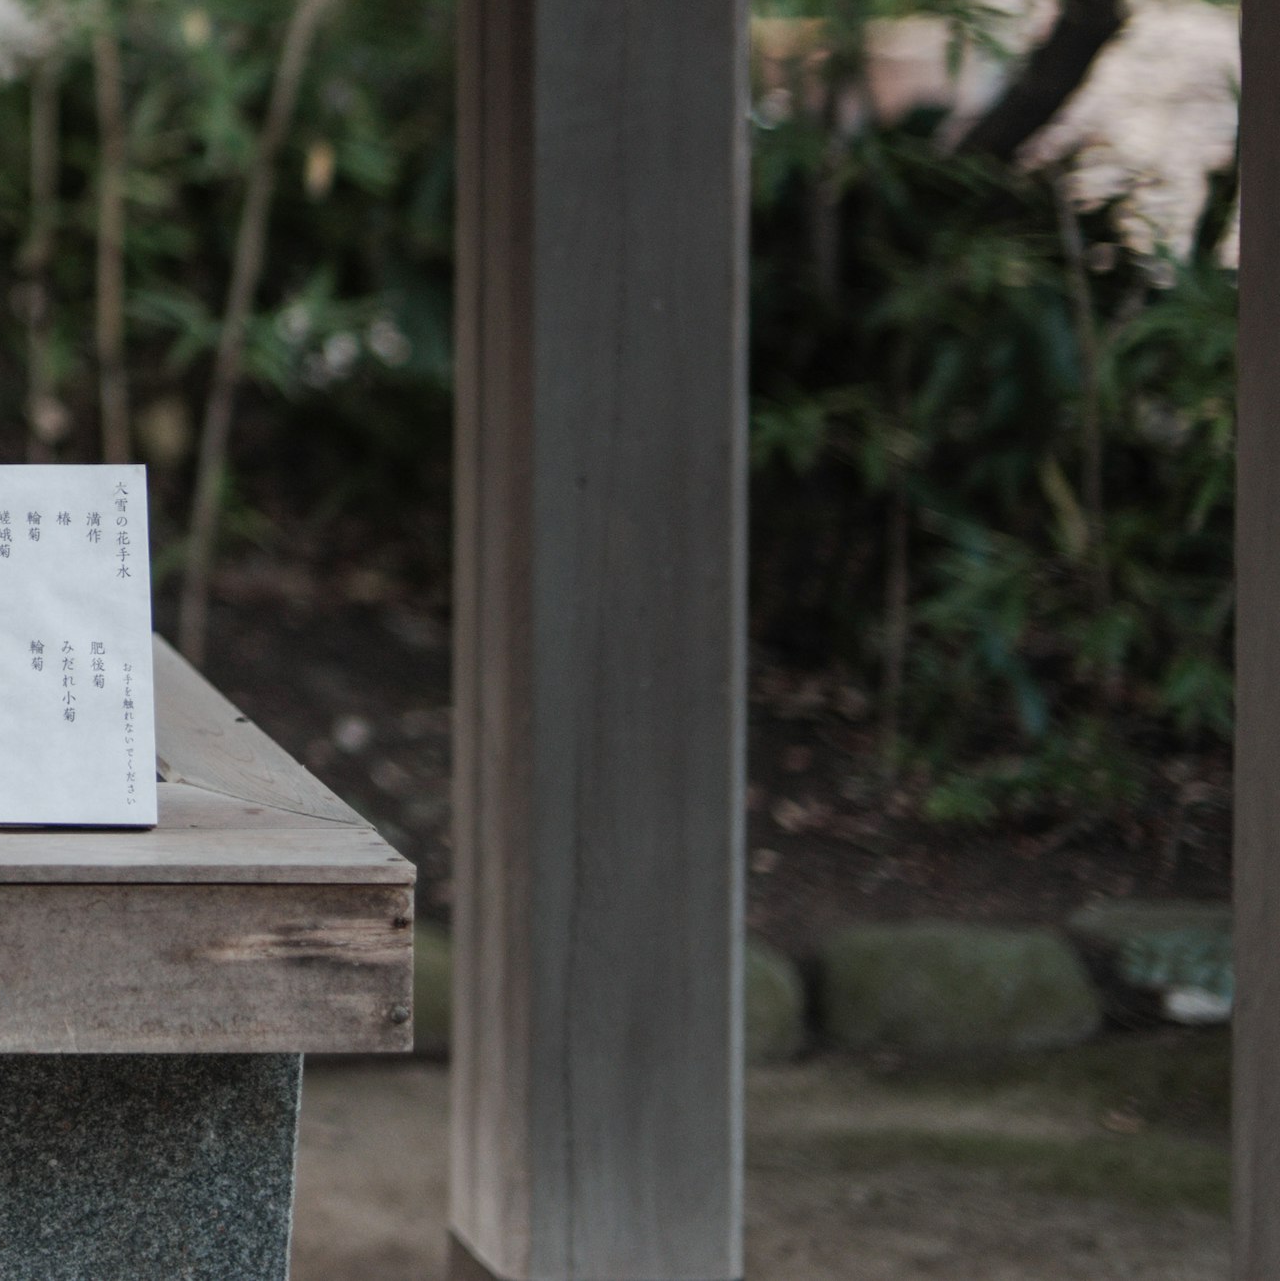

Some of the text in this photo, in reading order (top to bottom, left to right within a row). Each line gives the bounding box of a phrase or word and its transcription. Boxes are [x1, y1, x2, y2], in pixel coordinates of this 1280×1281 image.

[26, 510, 42, 542] 輪菊
[56, 511, 72, 526] 椿
[86, 511, 102, 543] 満作
[113, 481, 131, 578] 大雪の花手水
[29, 639, 45, 672] 輪菊
[90, 641, 105, 689] 肥後菊
[61, 640, 76, 723] みだれ小菊
[122, 663, 136, 806] お手を触れないでください
